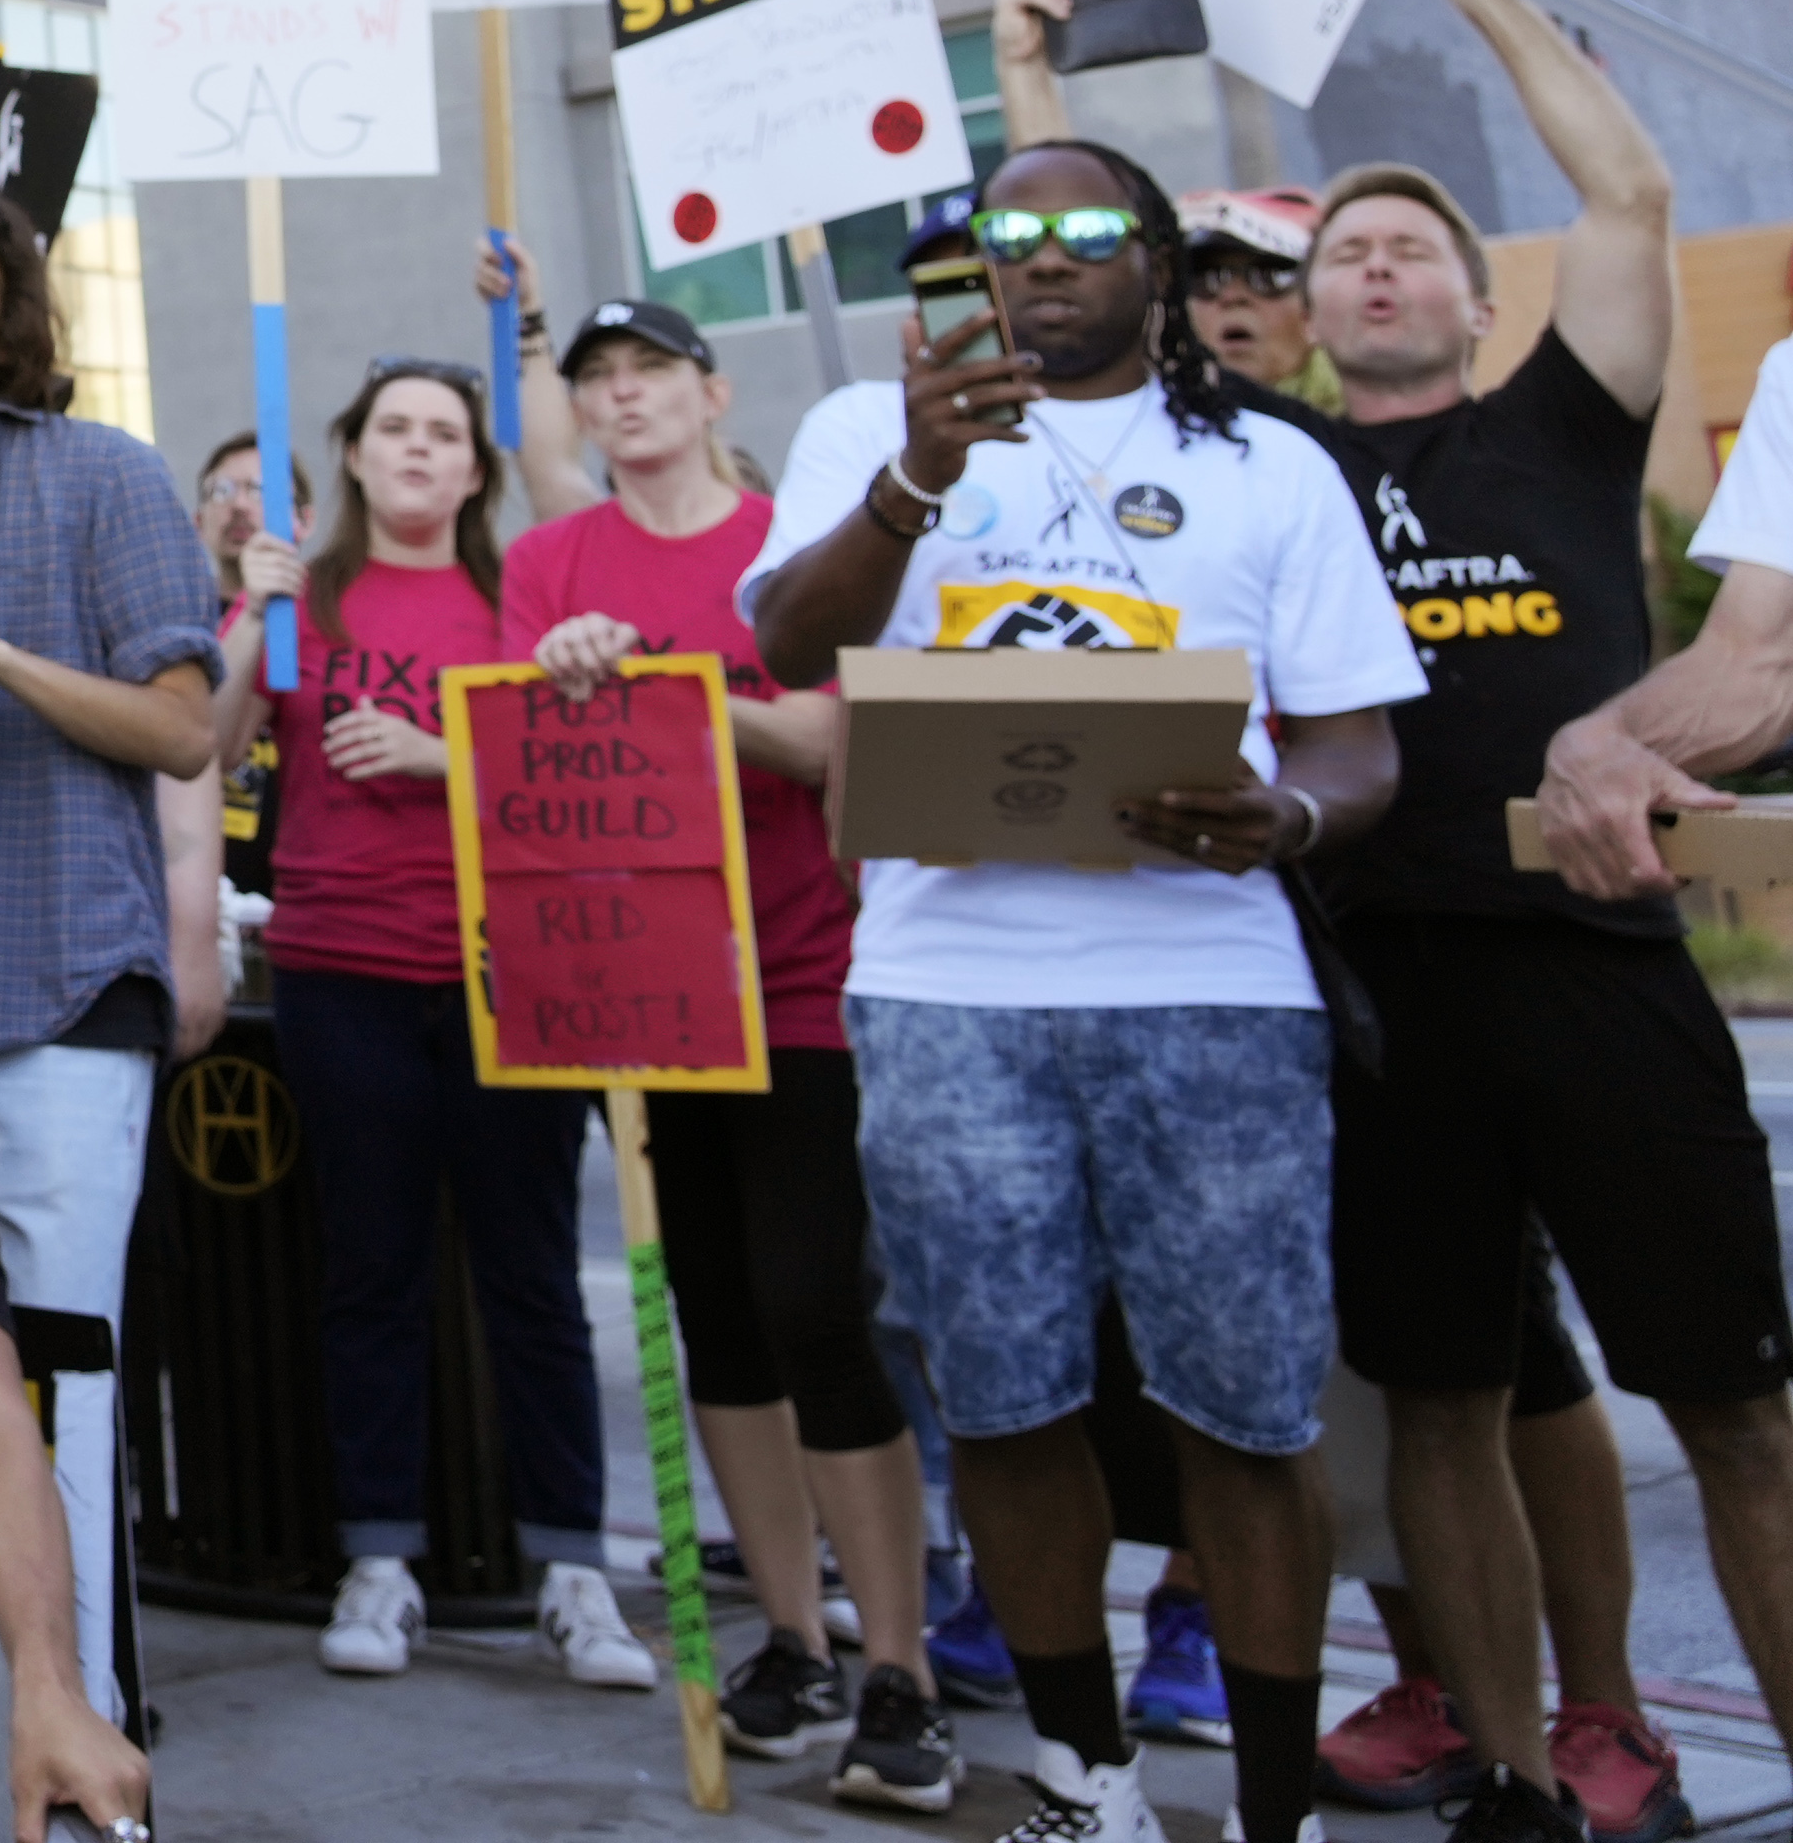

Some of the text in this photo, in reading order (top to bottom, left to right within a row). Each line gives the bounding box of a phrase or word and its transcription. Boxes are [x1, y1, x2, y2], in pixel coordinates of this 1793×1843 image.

[175, 56, 380, 160] SAG
[324, 646, 418, 695] FIX
[522, 676, 652, 731] POST
[520, 736, 667, 785] PROD.
[497, 790, 679, 843] GUILD
[535, 895, 649, 946] RED
